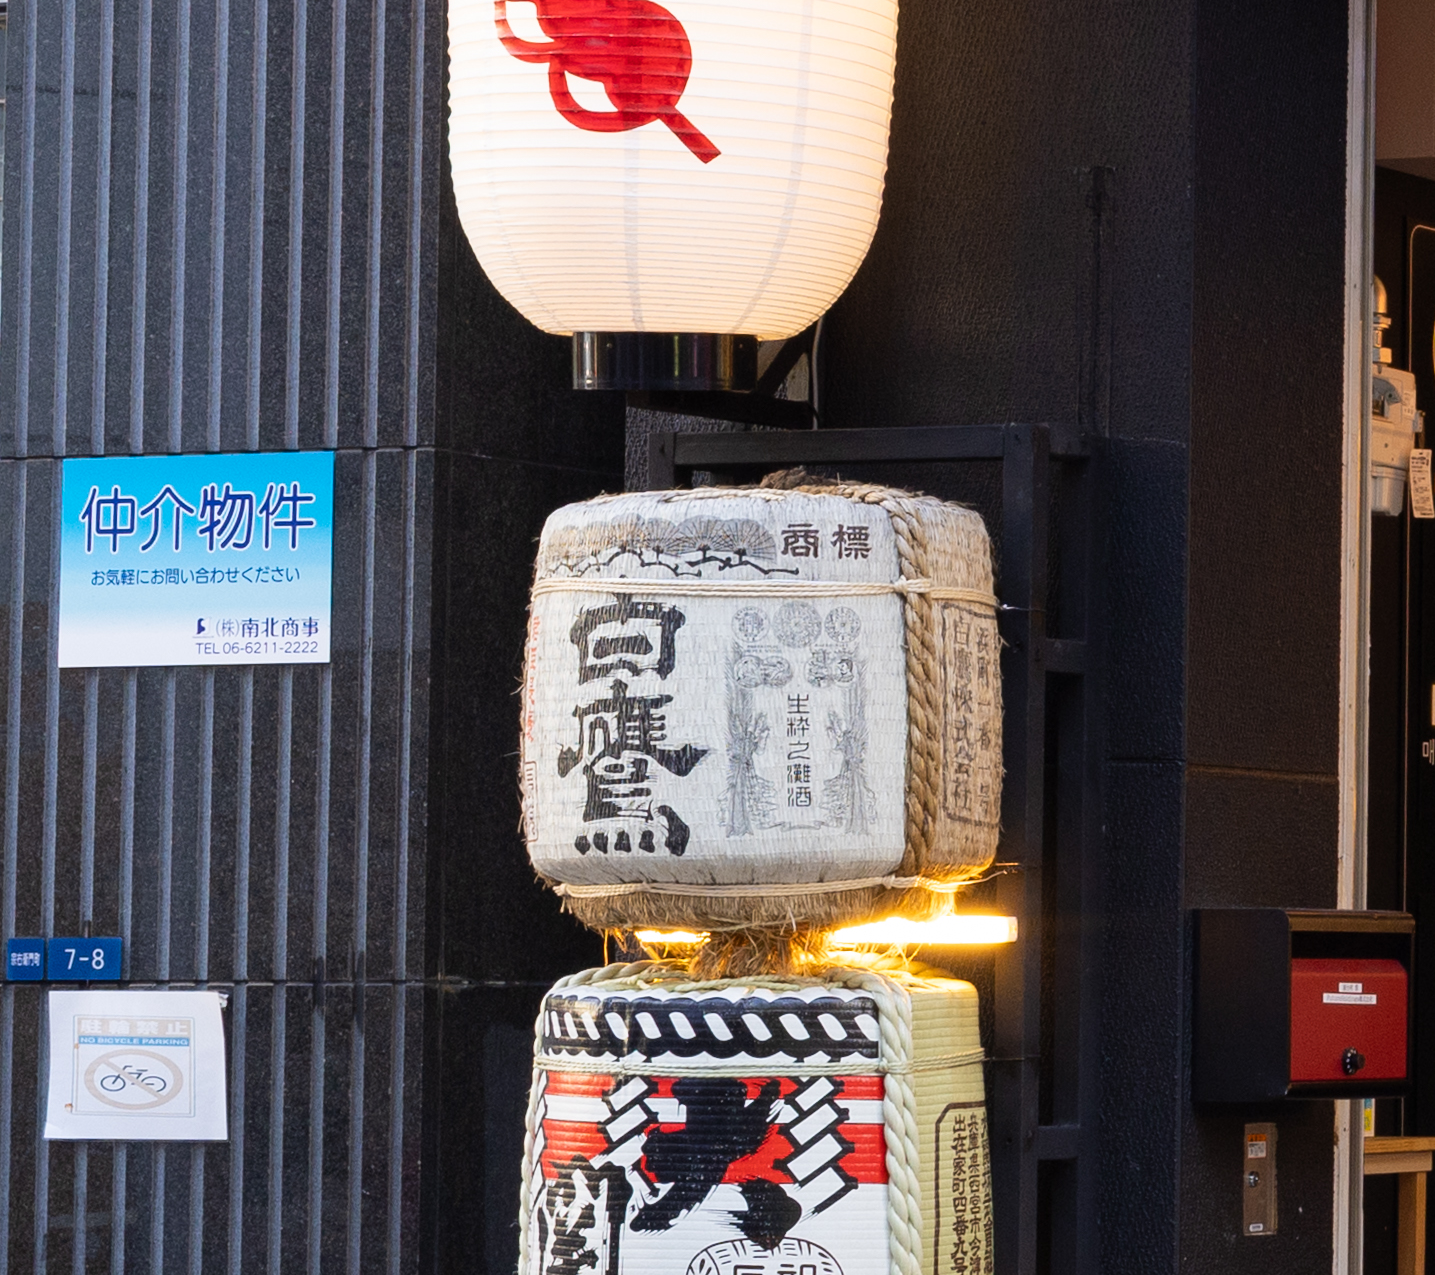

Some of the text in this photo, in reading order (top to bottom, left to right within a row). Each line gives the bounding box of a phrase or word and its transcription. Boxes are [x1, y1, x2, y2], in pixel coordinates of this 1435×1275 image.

[80, 482, 316, 554] 仲介物件
[780, 523, 873, 561] 商標
[90, 567, 301, 586] お気軽にお問い合わせください
[214, 616, 320, 639] (株)南北商事
[196, 641, 319, 655] TEL 06-6211-2222
[557, 574, 710, 857] 白鷹
[64, 947, 105, 970] 7-8
[79, 1018, 189, 1036] 駐輪禁止
[79, 1036, 189, 1046] NO BICYCLE PARKING
